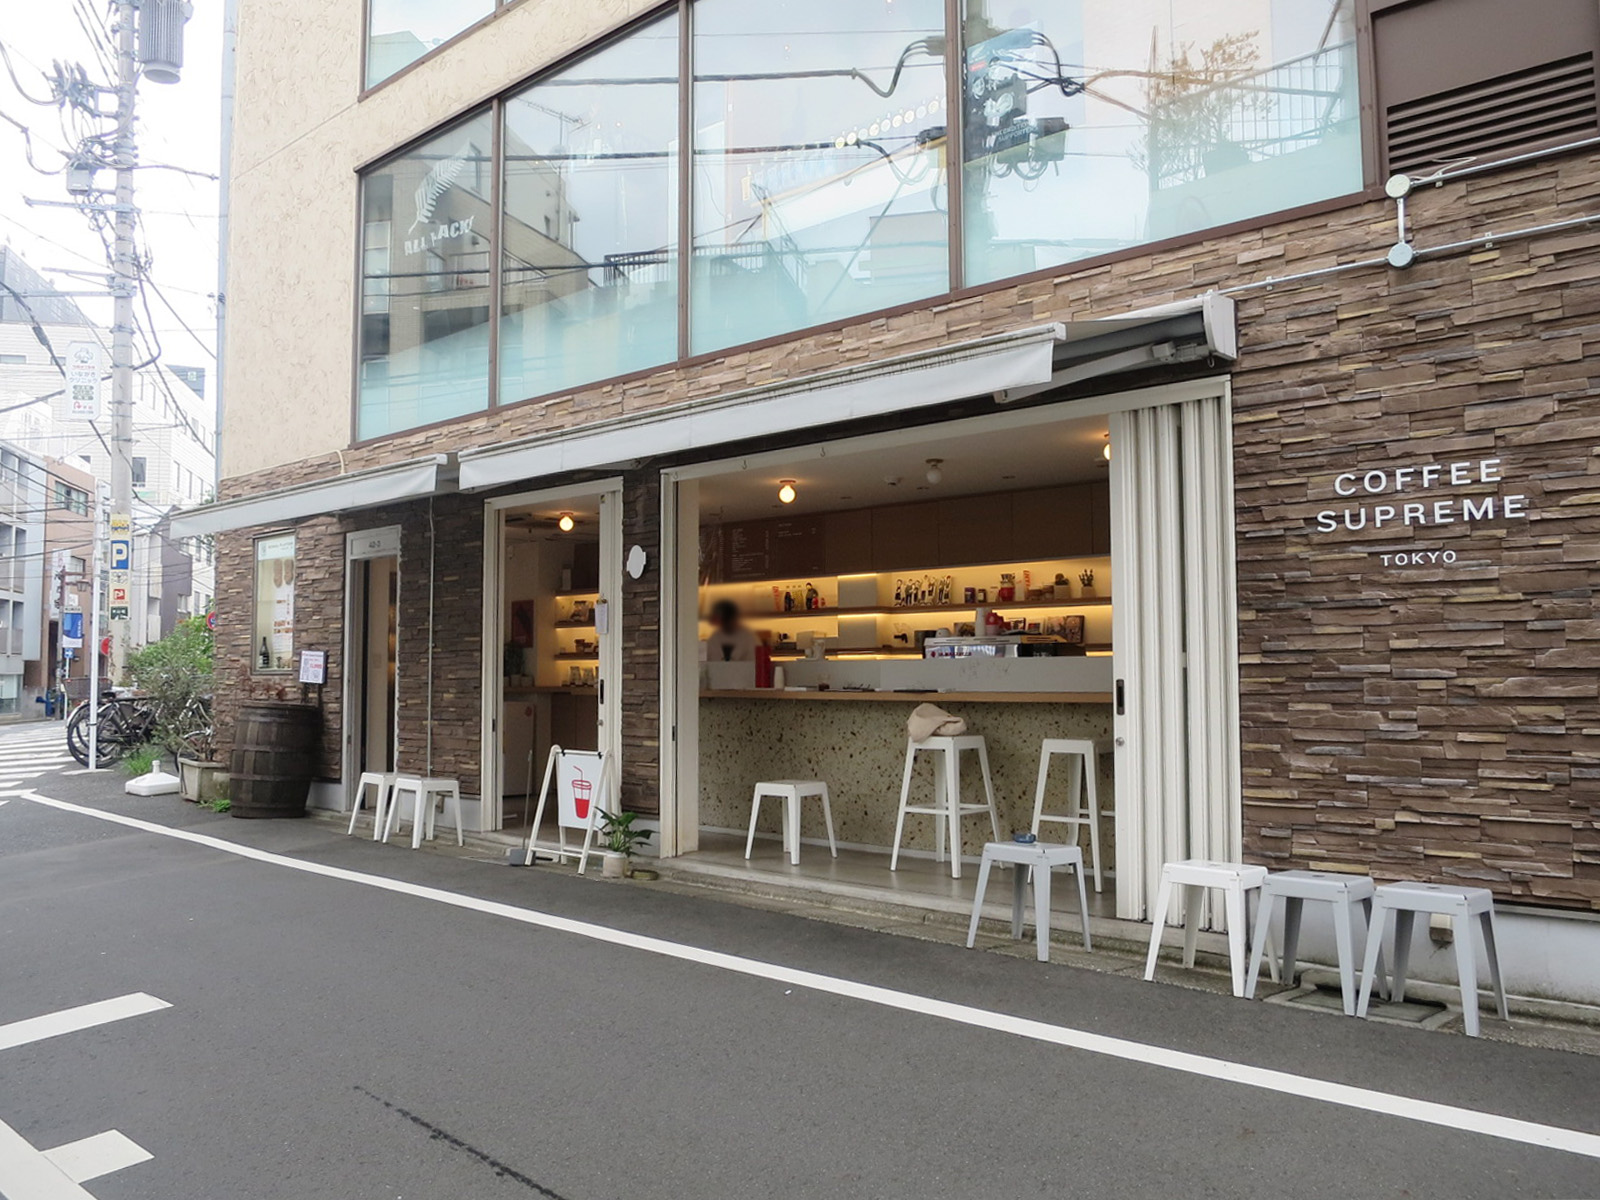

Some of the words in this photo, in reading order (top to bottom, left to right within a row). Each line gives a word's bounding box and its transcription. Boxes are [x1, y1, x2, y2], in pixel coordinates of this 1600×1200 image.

[1334, 459, 1502, 496] COFFEE
[1316, 494, 1526, 533] SUPREME
[112, 543, 127, 567] P
[1380, 550, 1457, 567] TOKYO
